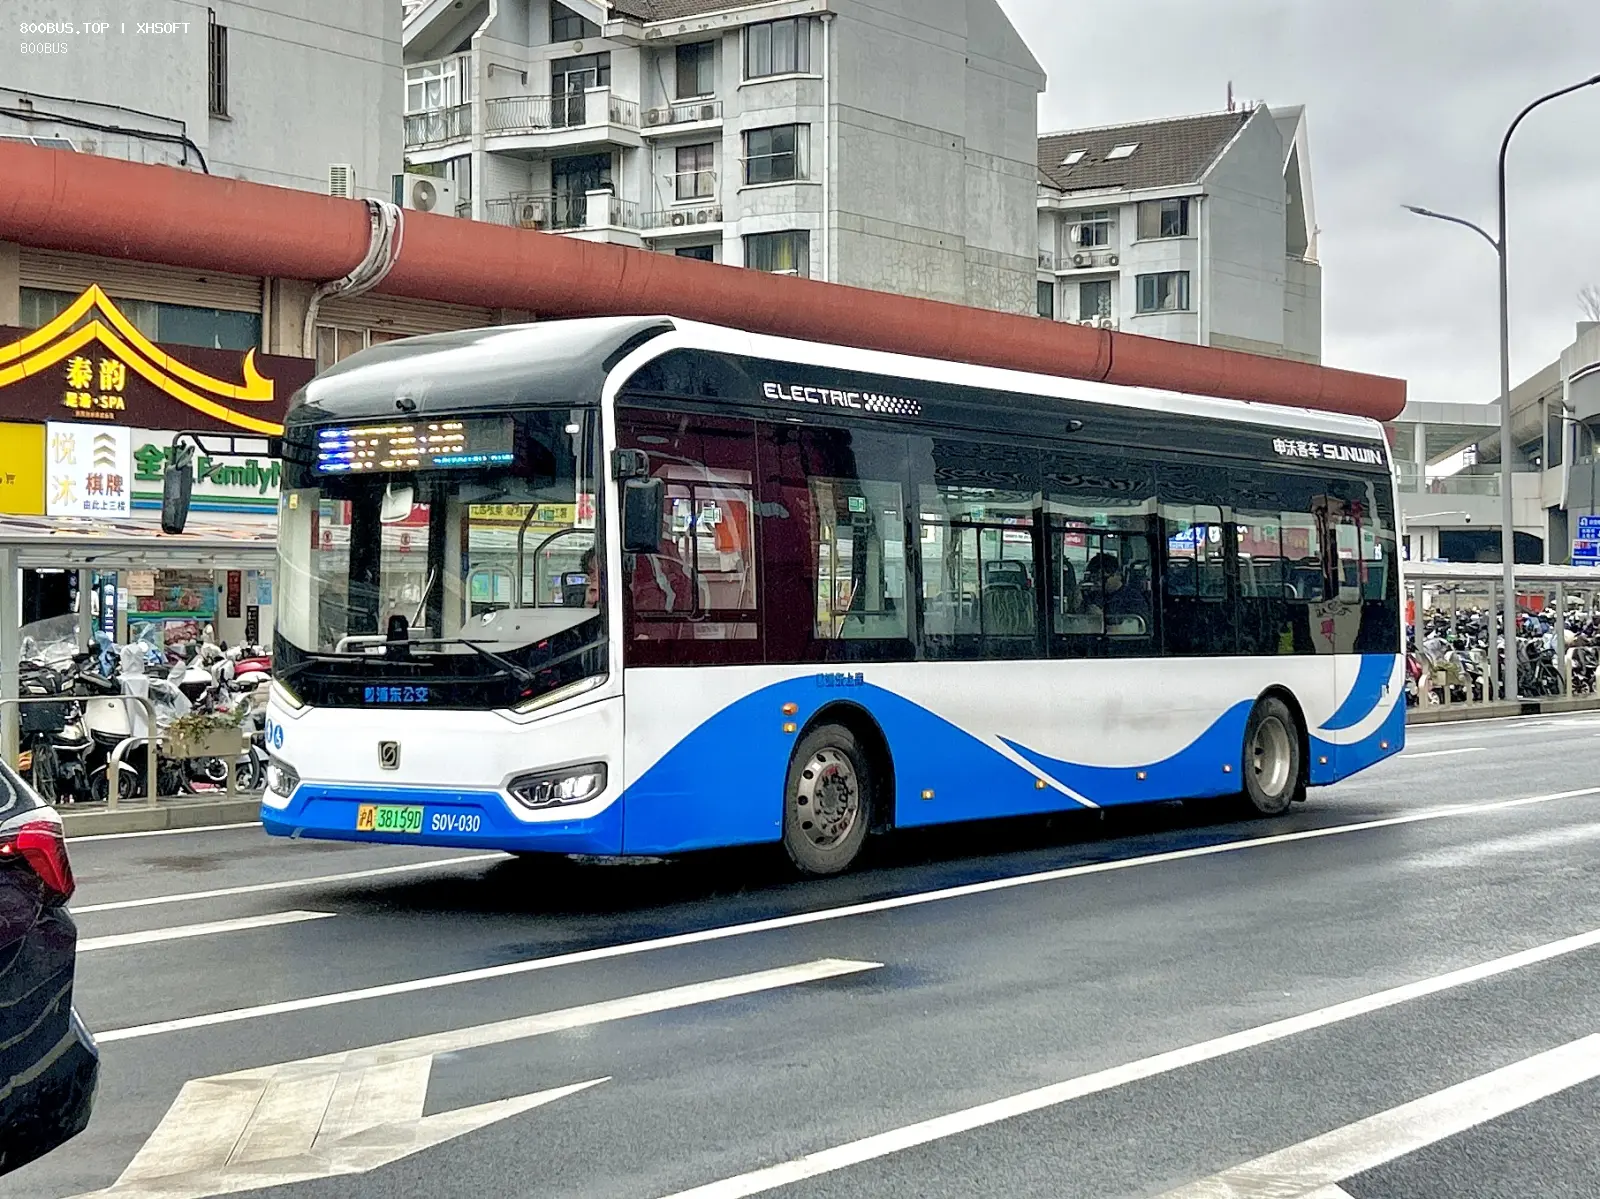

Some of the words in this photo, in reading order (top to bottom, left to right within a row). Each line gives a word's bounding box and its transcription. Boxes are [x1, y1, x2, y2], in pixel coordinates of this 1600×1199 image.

[763, 382, 861, 409] ELECTRIC
[1272, 438, 1320, 458] 申沃客车
[1322, 443, 1383, 465] SUNWIN
[85, 472, 125, 497] 棋牌
